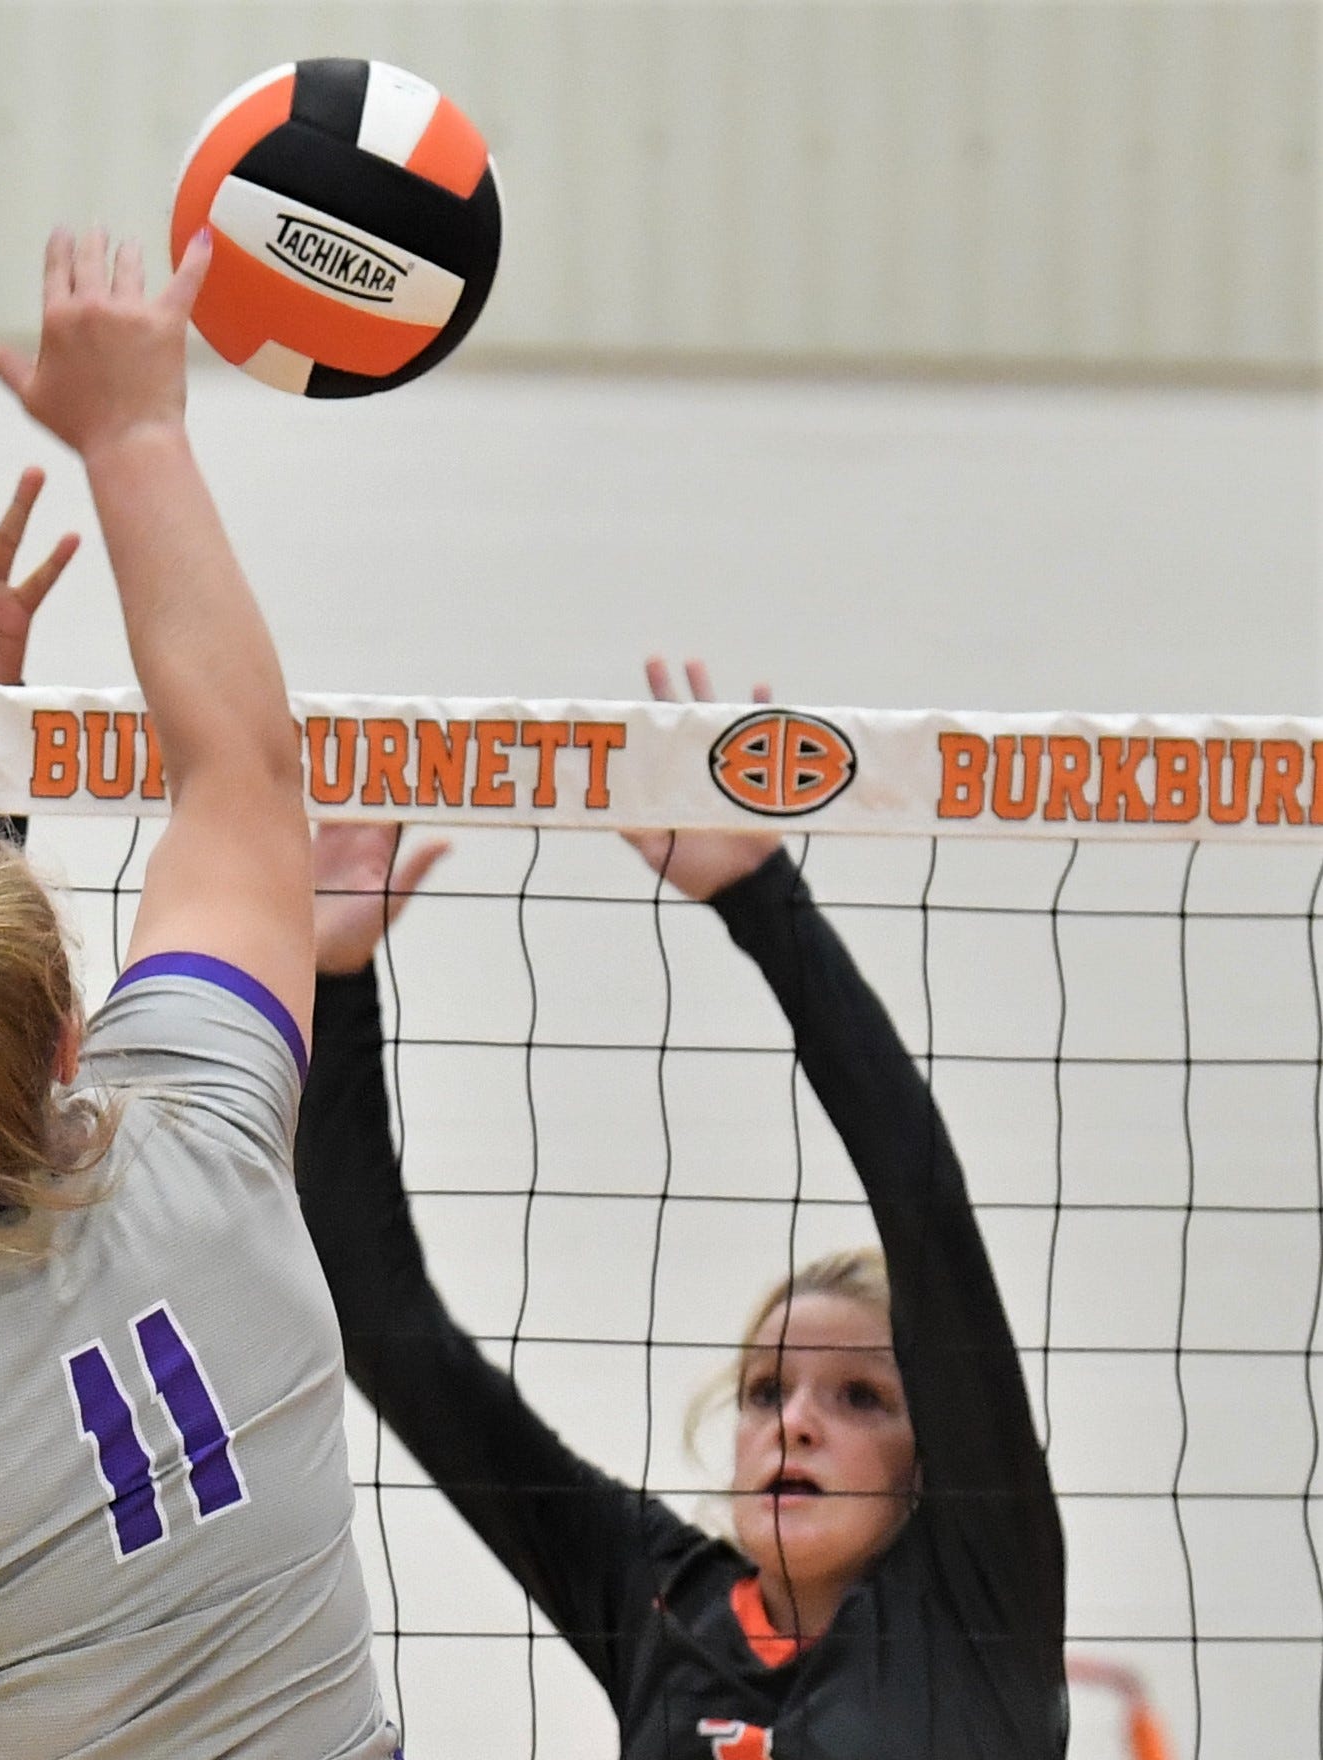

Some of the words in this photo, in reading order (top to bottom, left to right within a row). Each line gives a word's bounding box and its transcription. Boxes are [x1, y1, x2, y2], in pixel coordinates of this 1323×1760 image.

[275, 214, 398, 294] TACHIKARA
[30, 709, 626, 809] BUURNETT
[937, 731, 1323, 825] BURKBUR
[61, 1299, 251, 1564] 11
